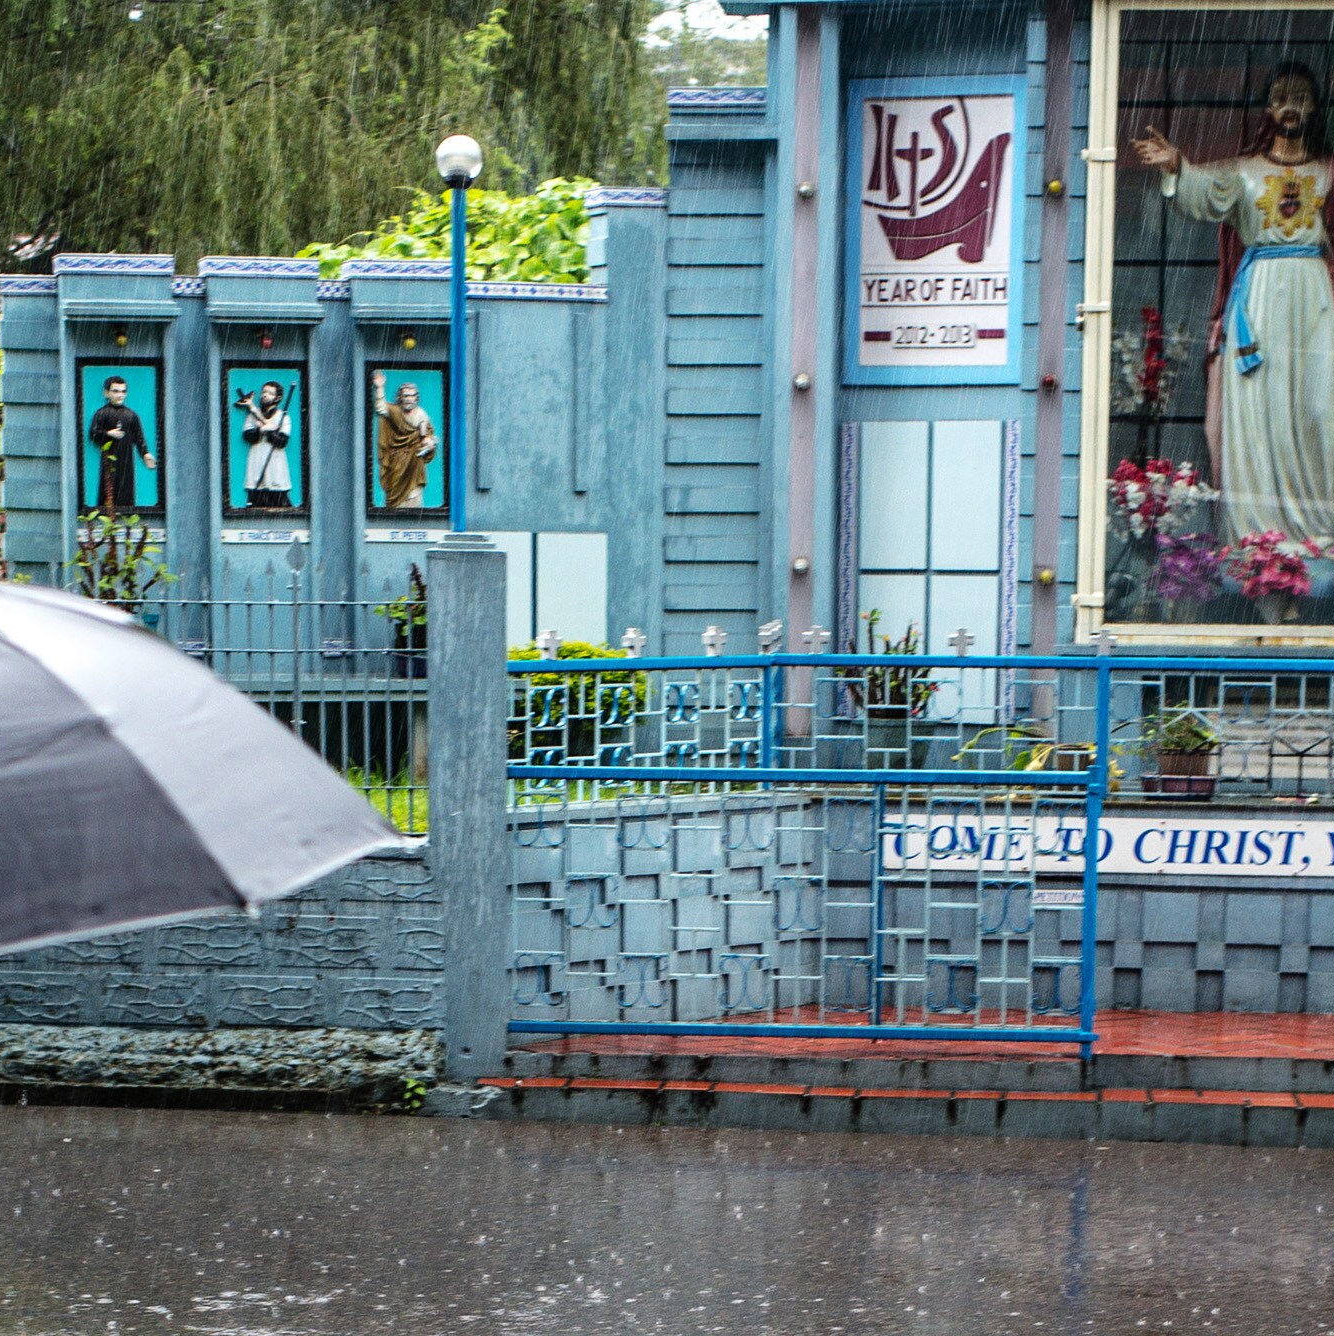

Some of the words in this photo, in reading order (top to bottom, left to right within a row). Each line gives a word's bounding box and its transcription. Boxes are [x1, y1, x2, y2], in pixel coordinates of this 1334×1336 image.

[863, 278, 916, 302] YEAR
[920, 277, 946, 302] OF
[951, 276, 1008, 301] FAITH
[893, 824, 1030, 862] COME
[1055, 827, 1113, 864] TO
[1134, 828, 1311, 872] CHRIST,
